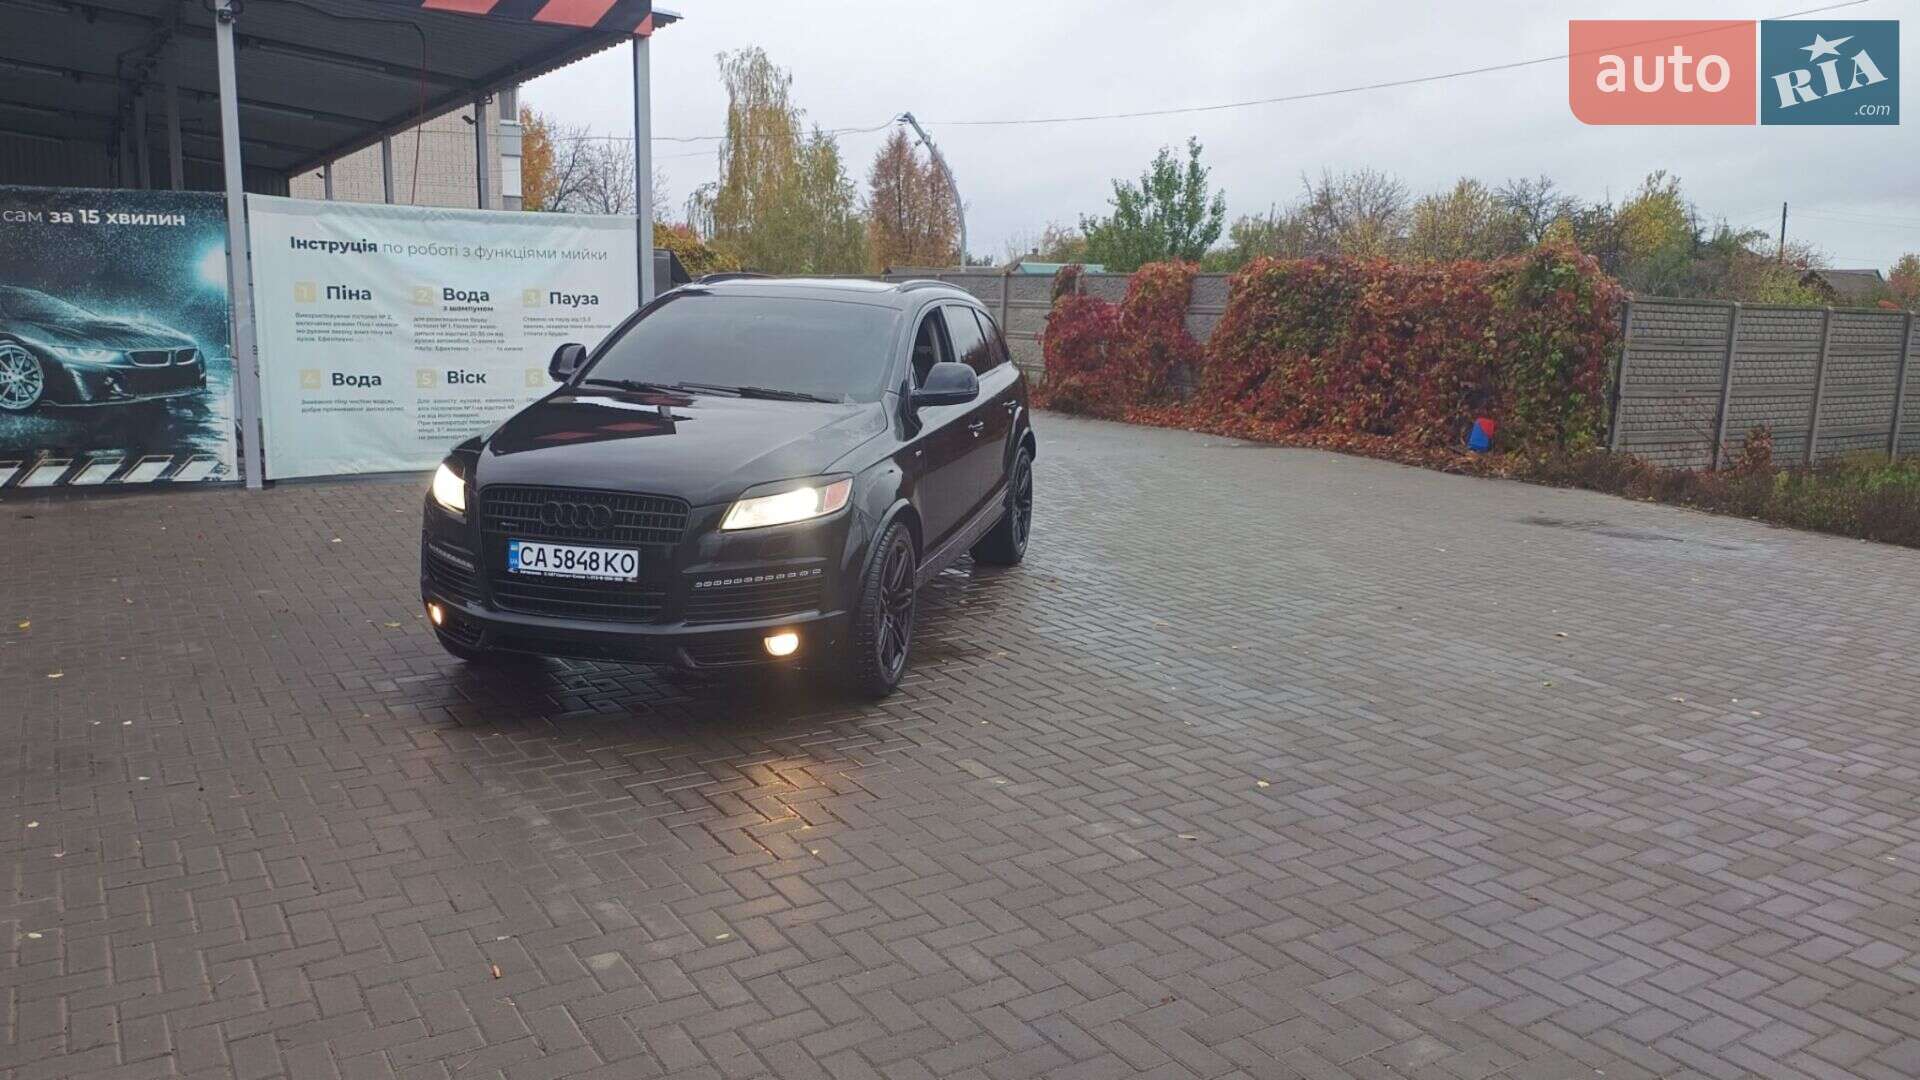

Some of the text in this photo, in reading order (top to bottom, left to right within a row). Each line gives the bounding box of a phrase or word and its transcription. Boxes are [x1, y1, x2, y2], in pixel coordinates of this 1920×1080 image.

[3, 209, 186, 226] сам за 15 хвилин
[290, 236, 608, 261] Інструція по роботі з функціями мийки
[326, 284, 372, 301] Піна
[443, 287, 490, 303] Вода
[549, 291, 599, 308] Пауза
[331, 372, 382, 388] Вода
[446, 369, 487, 384] Віск
[520, 546, 636, 574] CA 5848 KO
